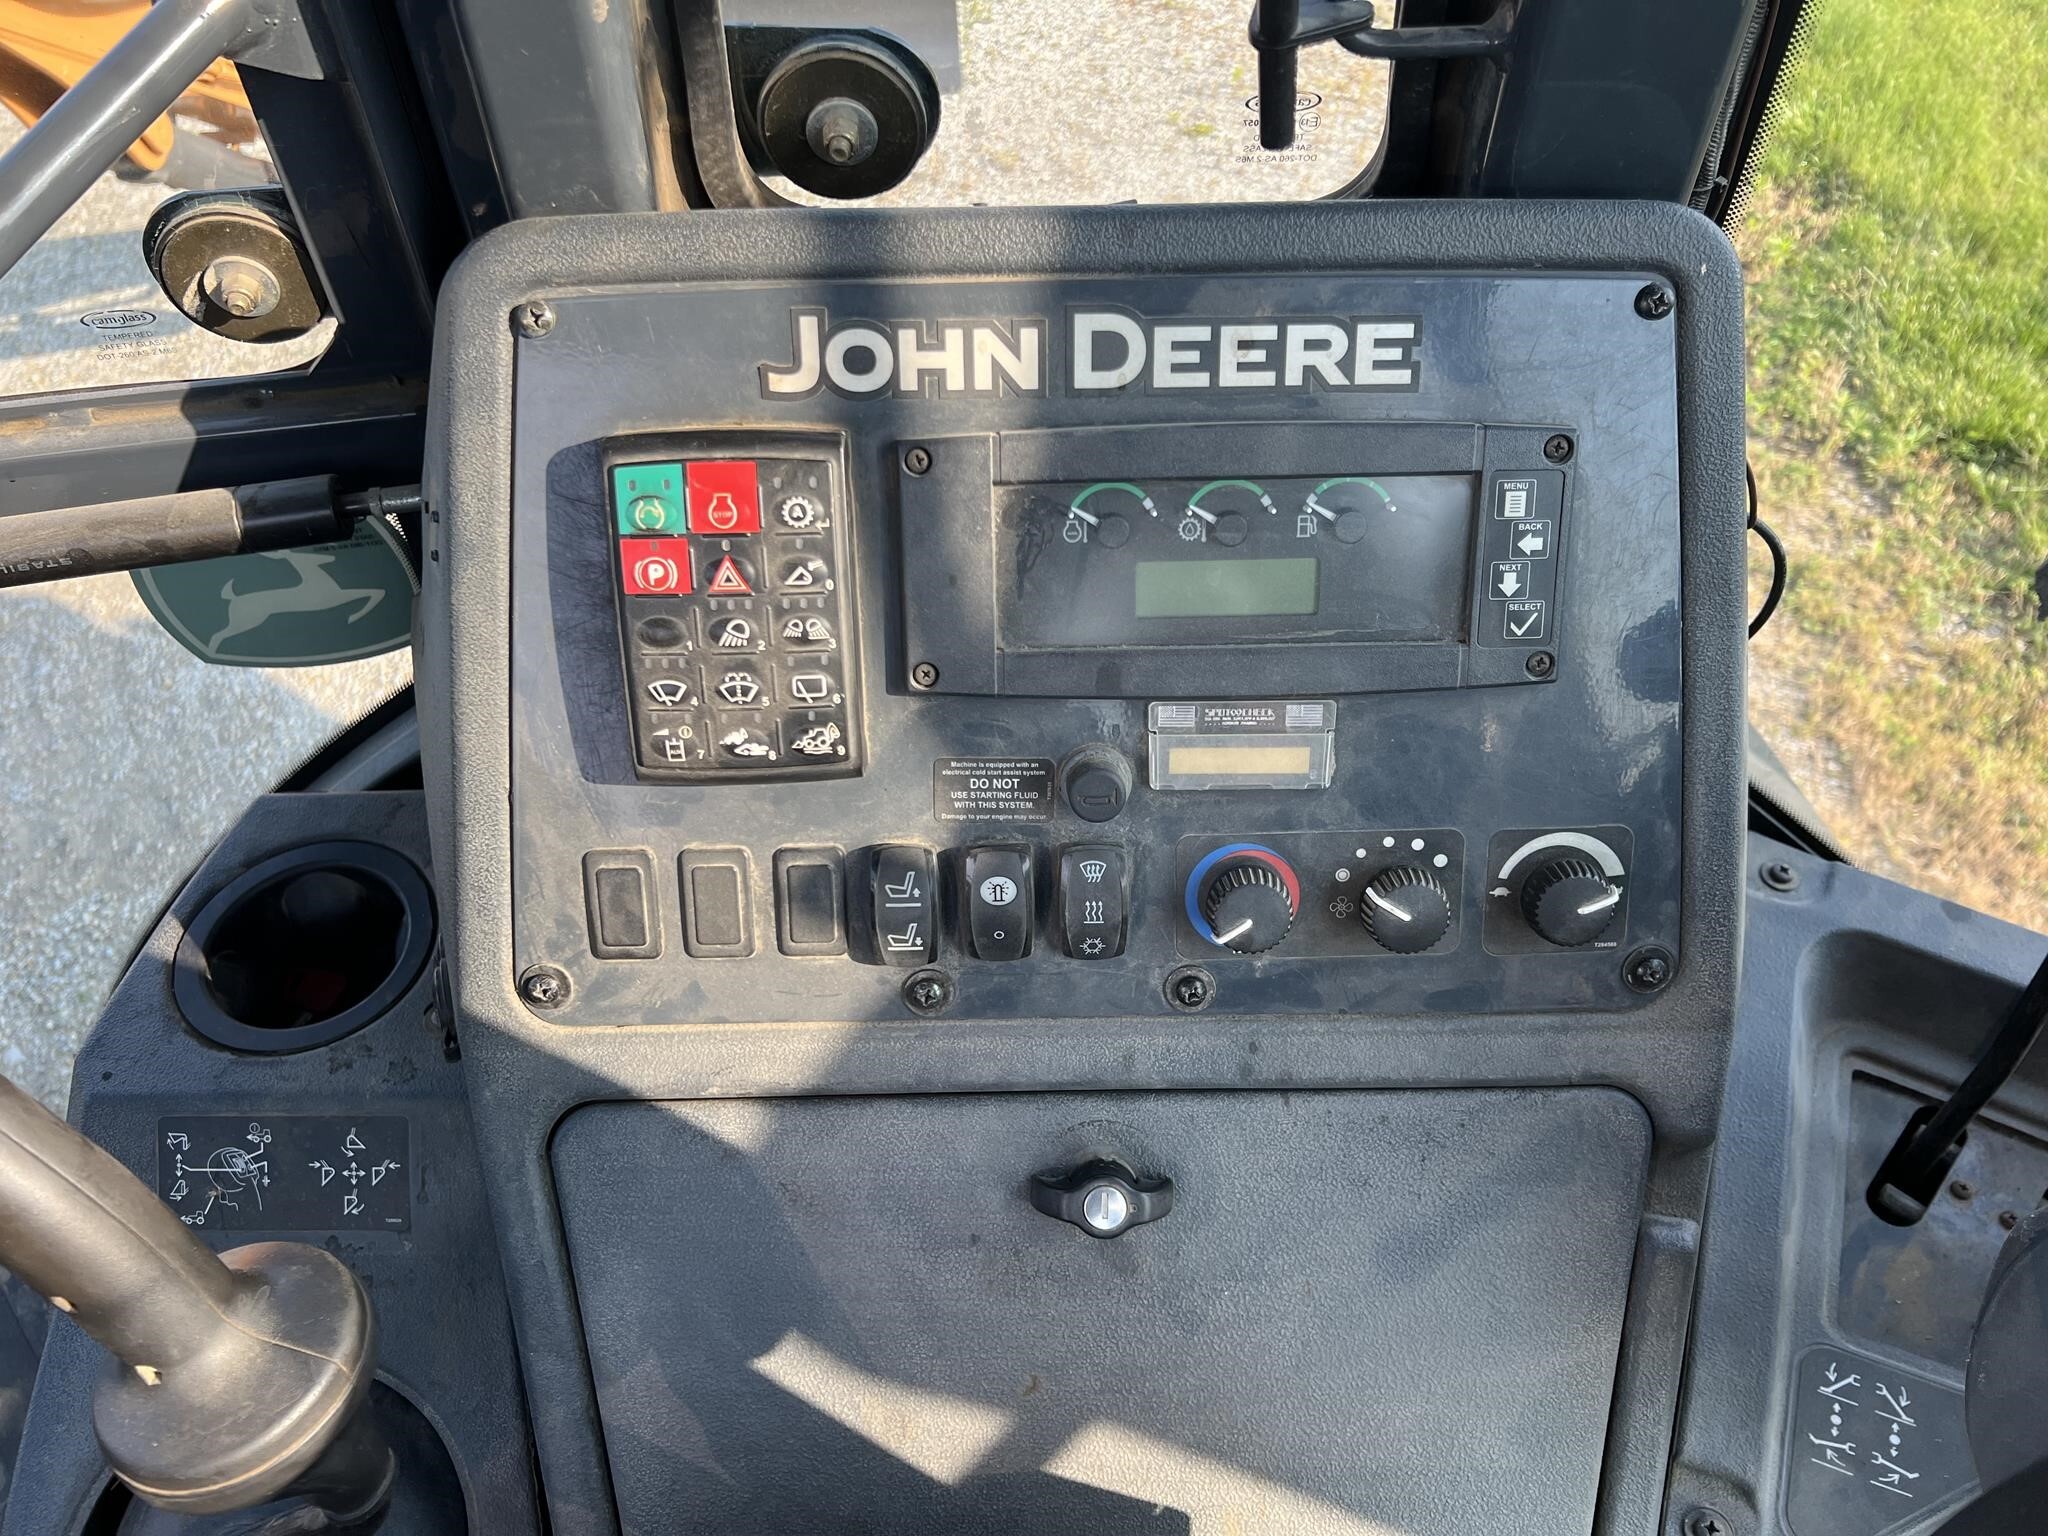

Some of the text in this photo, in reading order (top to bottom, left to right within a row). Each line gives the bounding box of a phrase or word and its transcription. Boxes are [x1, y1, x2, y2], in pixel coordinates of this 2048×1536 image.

[101, 331, 153, 341] TEMPERED
[98, 338, 168, 352] SAFETY GLASS
[768, 313, 1415, 393] JOHN DEERE
[0, 557, 73, 574] STABIL
[648, 563, 665, 586] P
[686, 640, 693, 651] 1
[758, 640, 766, 650] 2
[829, 638, 837, 648] 3
[762, 696, 770, 707] 5
[833, 693, 842, 704] 6
[697, 749, 705, 760] 7
[837, 745, 846, 756] 9
[986, 761, 1015, 769] equipped
[970, 778, 1020, 789] DO NOT
[970, 791, 1012, 799] STARTING
[1014, 791, 1039, 799] FLUID
[999, 801, 1034, 809] SYSTEM.
